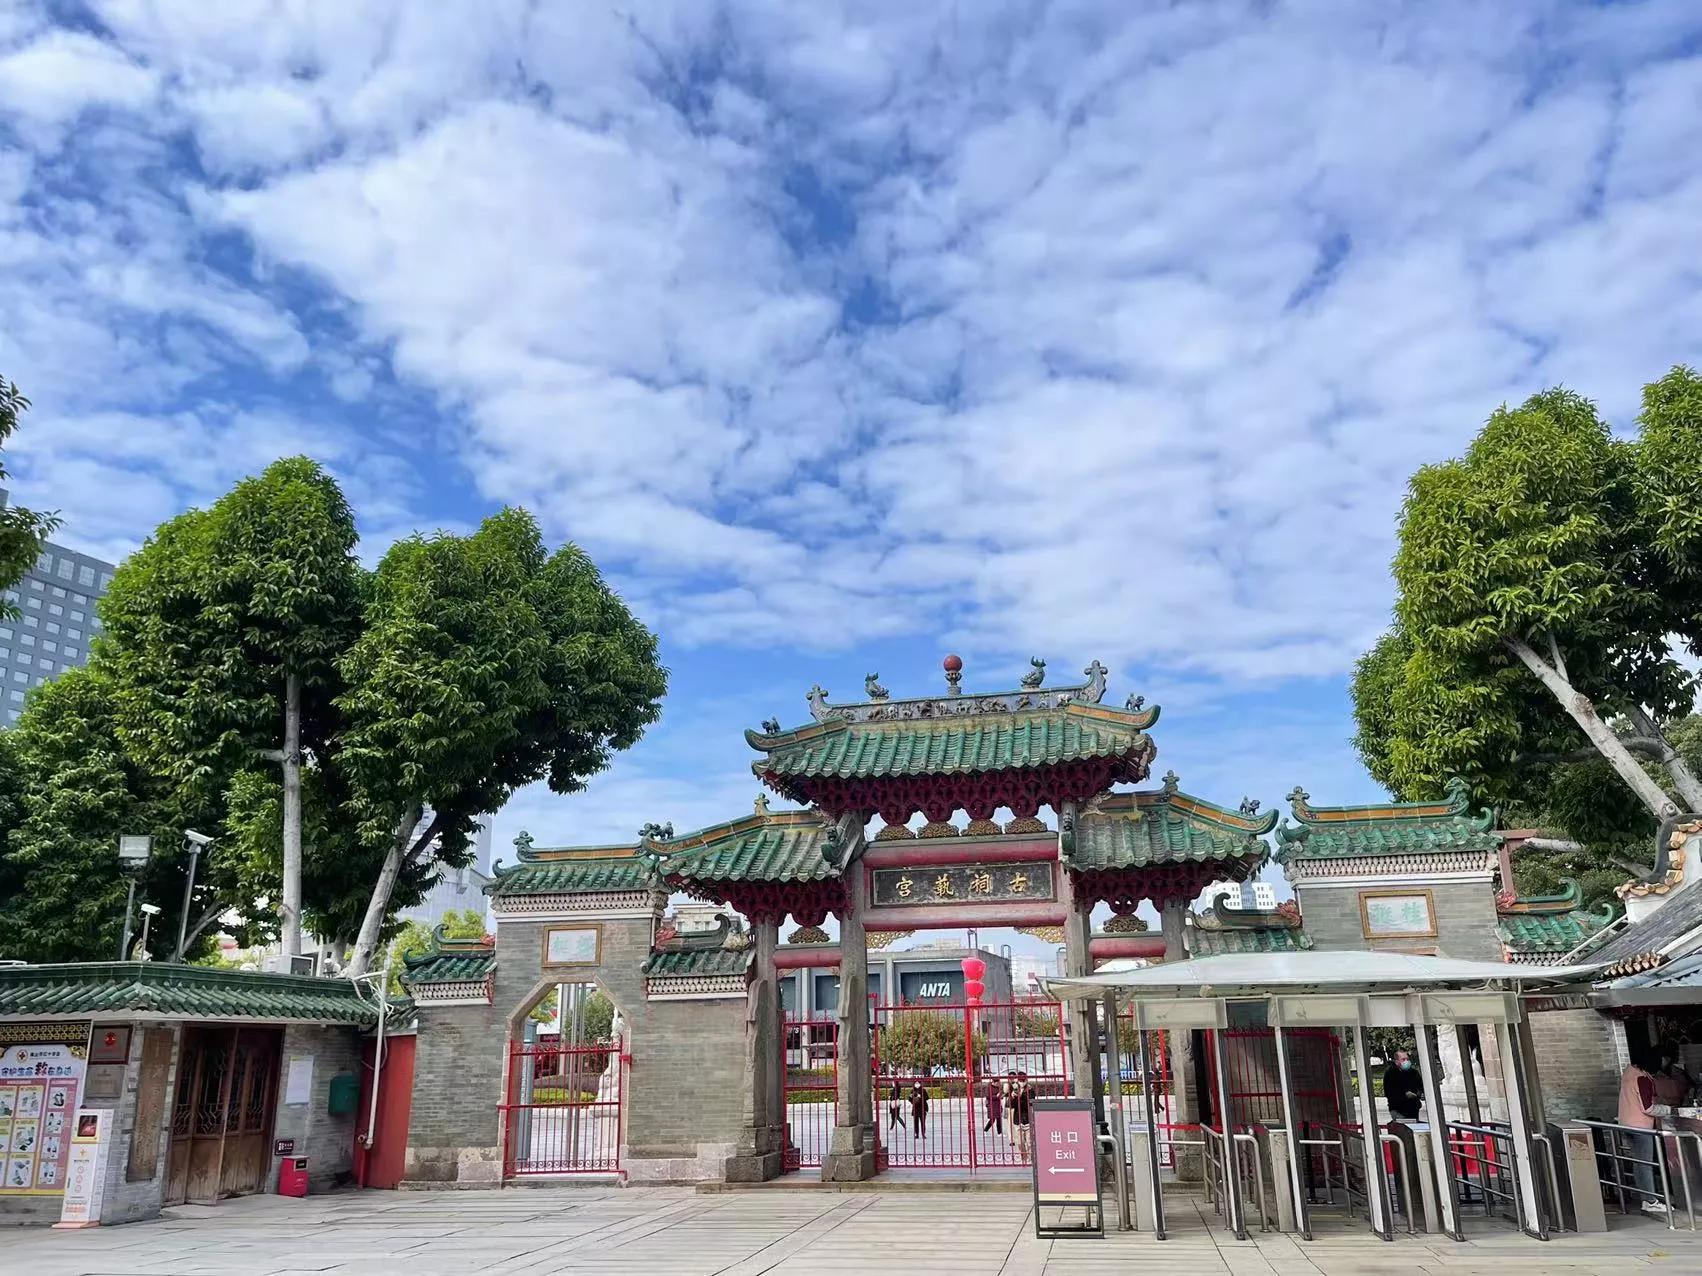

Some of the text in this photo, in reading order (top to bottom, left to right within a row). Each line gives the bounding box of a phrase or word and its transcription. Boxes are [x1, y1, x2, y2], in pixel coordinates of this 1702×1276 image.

[919, 982, 951, 997] ANTA
[1050, 1130, 1078, 1144] 出口
[1055, 1149, 1076, 1160] Exit
